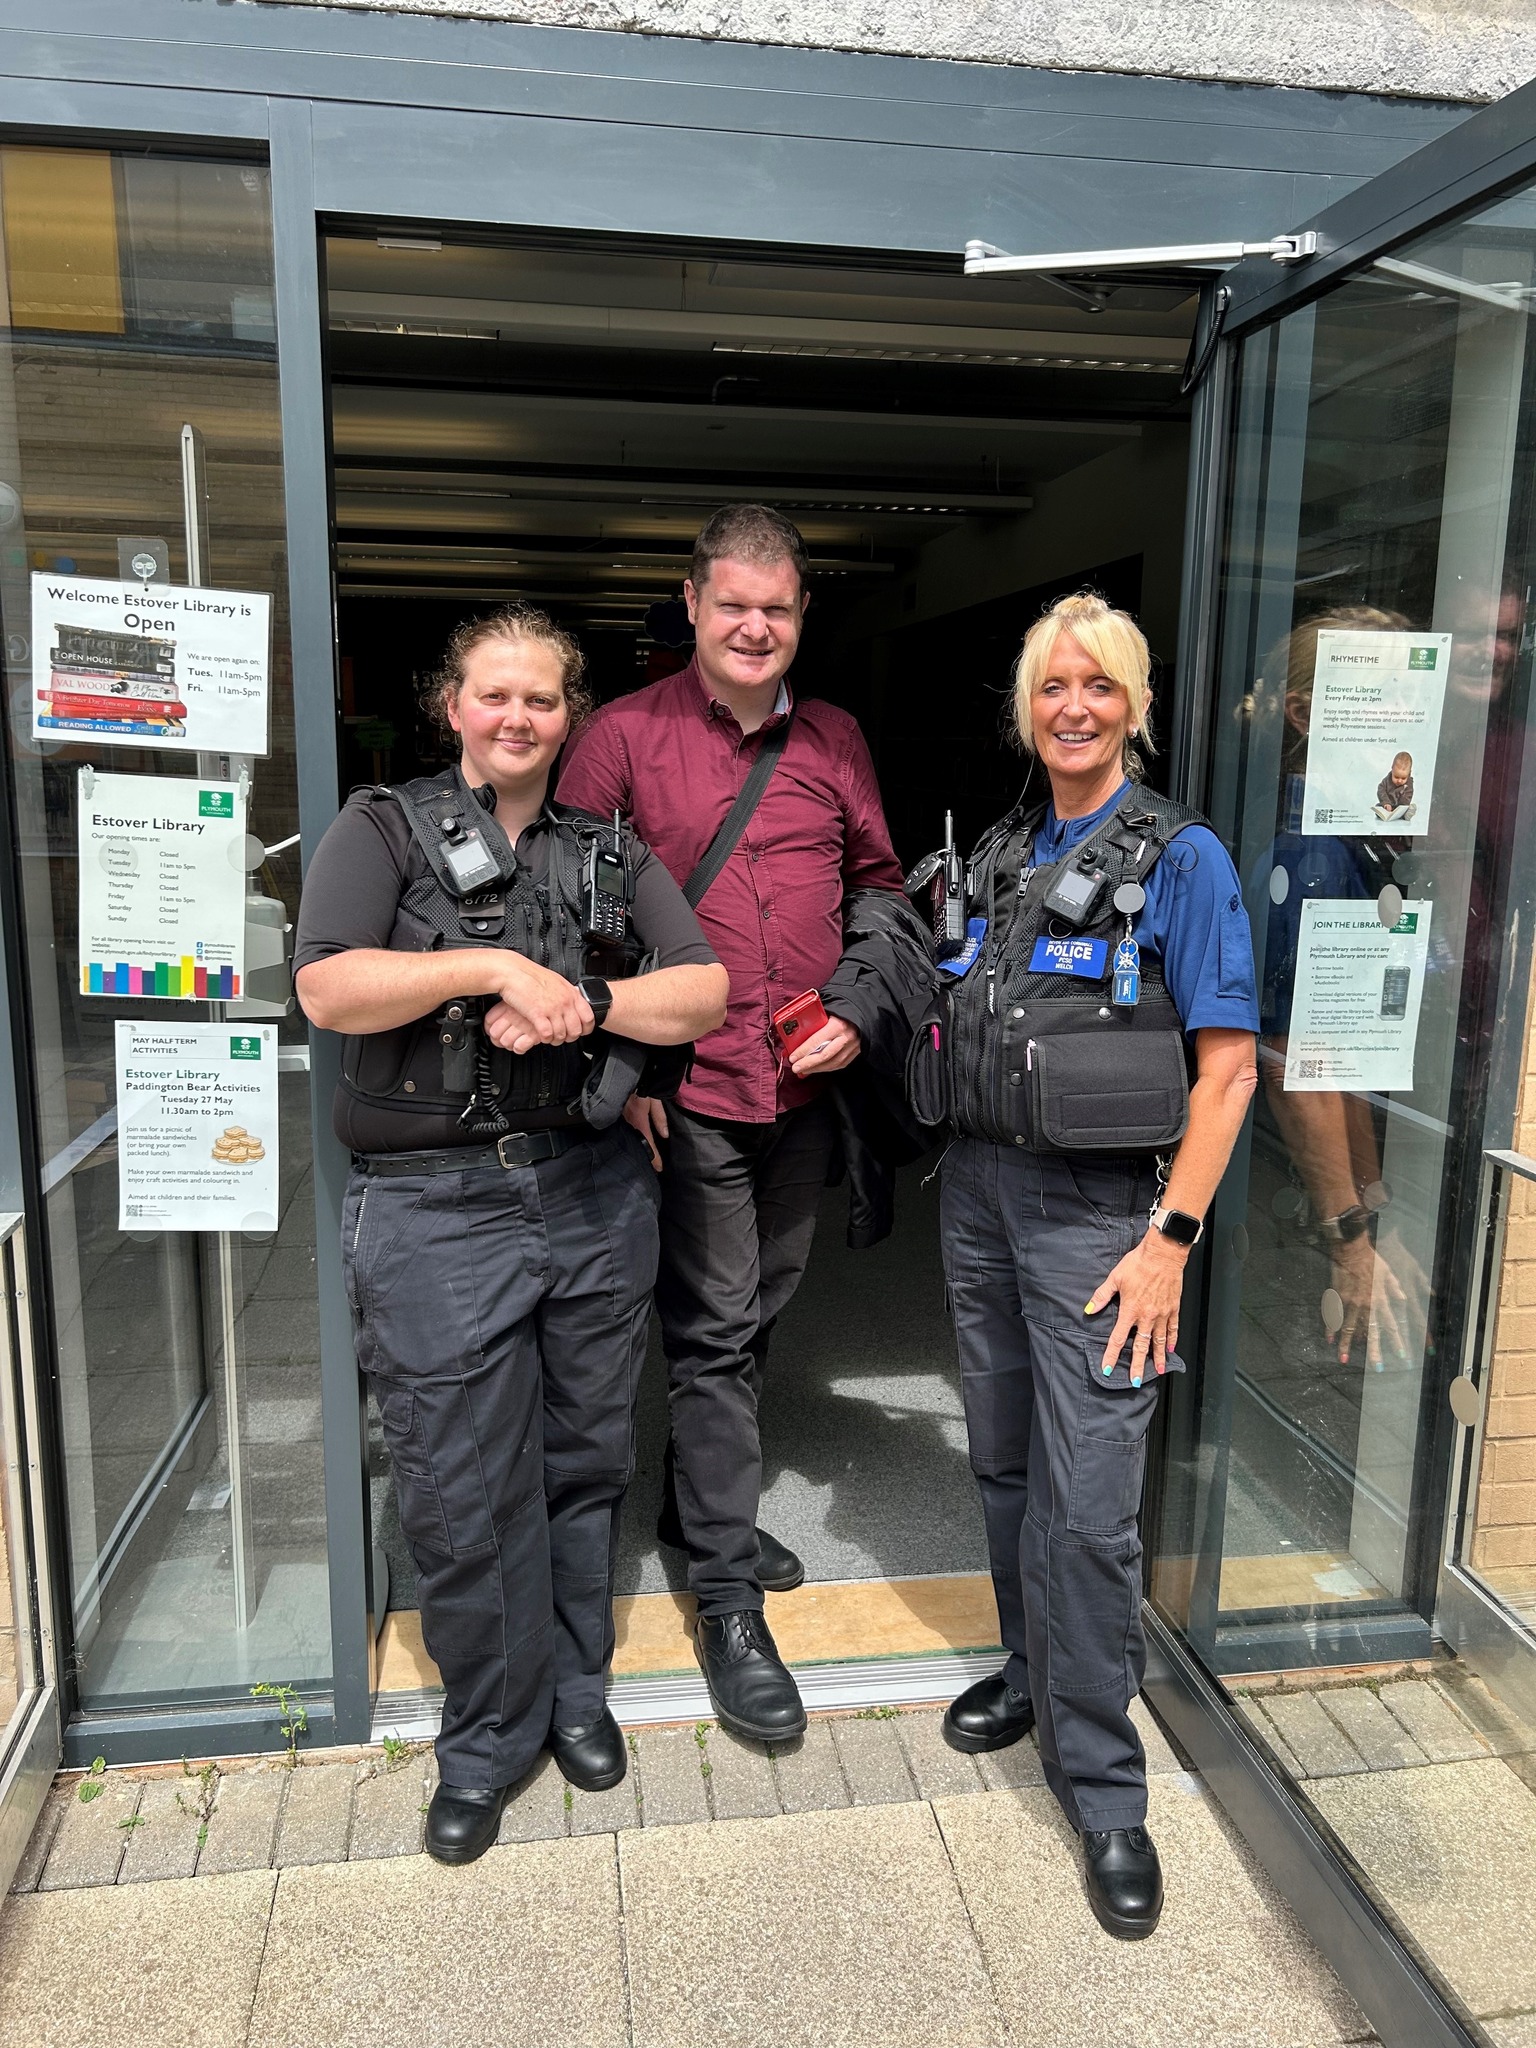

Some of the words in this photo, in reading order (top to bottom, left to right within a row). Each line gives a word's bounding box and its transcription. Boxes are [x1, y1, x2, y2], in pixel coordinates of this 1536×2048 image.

[48, 588, 119, 605] Welcome
[125, 595, 179, 610] Estover
[184, 600, 236, 617] Library
[241, 605, 251, 616] is
[124, 614, 176, 633] Open
[61, 652, 84, 661] OPEN
[87, 656, 113, 665] HOUSE
[1331, 655, 1379, 663] RHYMETIME
[188, 668, 213, 677] Tues.
[220, 670, 262, 682] 11am-5pm
[57, 679, 74, 687] VAL
[77, 680, 110, 691] WOOD
[188, 684, 203, 692] Fri.
[219, 686, 260, 698] 11am-5pm
[1326, 685, 1353, 693] Estover
[1356, 686, 1382, 695] Library
[58, 721, 94, 730] READING
[95, 724, 131, 732] ALLOWED
[92, 815, 148, 829] Estover
[153, 818, 205, 835] Library
[108, 859, 131, 867] Tuesday
[108, 915, 127, 923] Sunday
[1046, 945, 1093, 960] POLICE
[126, 1069, 172, 1079] Estover
[176, 1070, 220, 1081] Library
[126, 1083, 184, 1093] Paddington
[187, 1083, 210, 1091] Bear
[214, 1084, 261, 1092] Activities
[161, 1096, 199, 1104] Tuesday
[215, 1097, 233, 1105] May
[161, 1107, 199, 1115] 11.30am
[214, 1109, 234, 1117] 2pm
